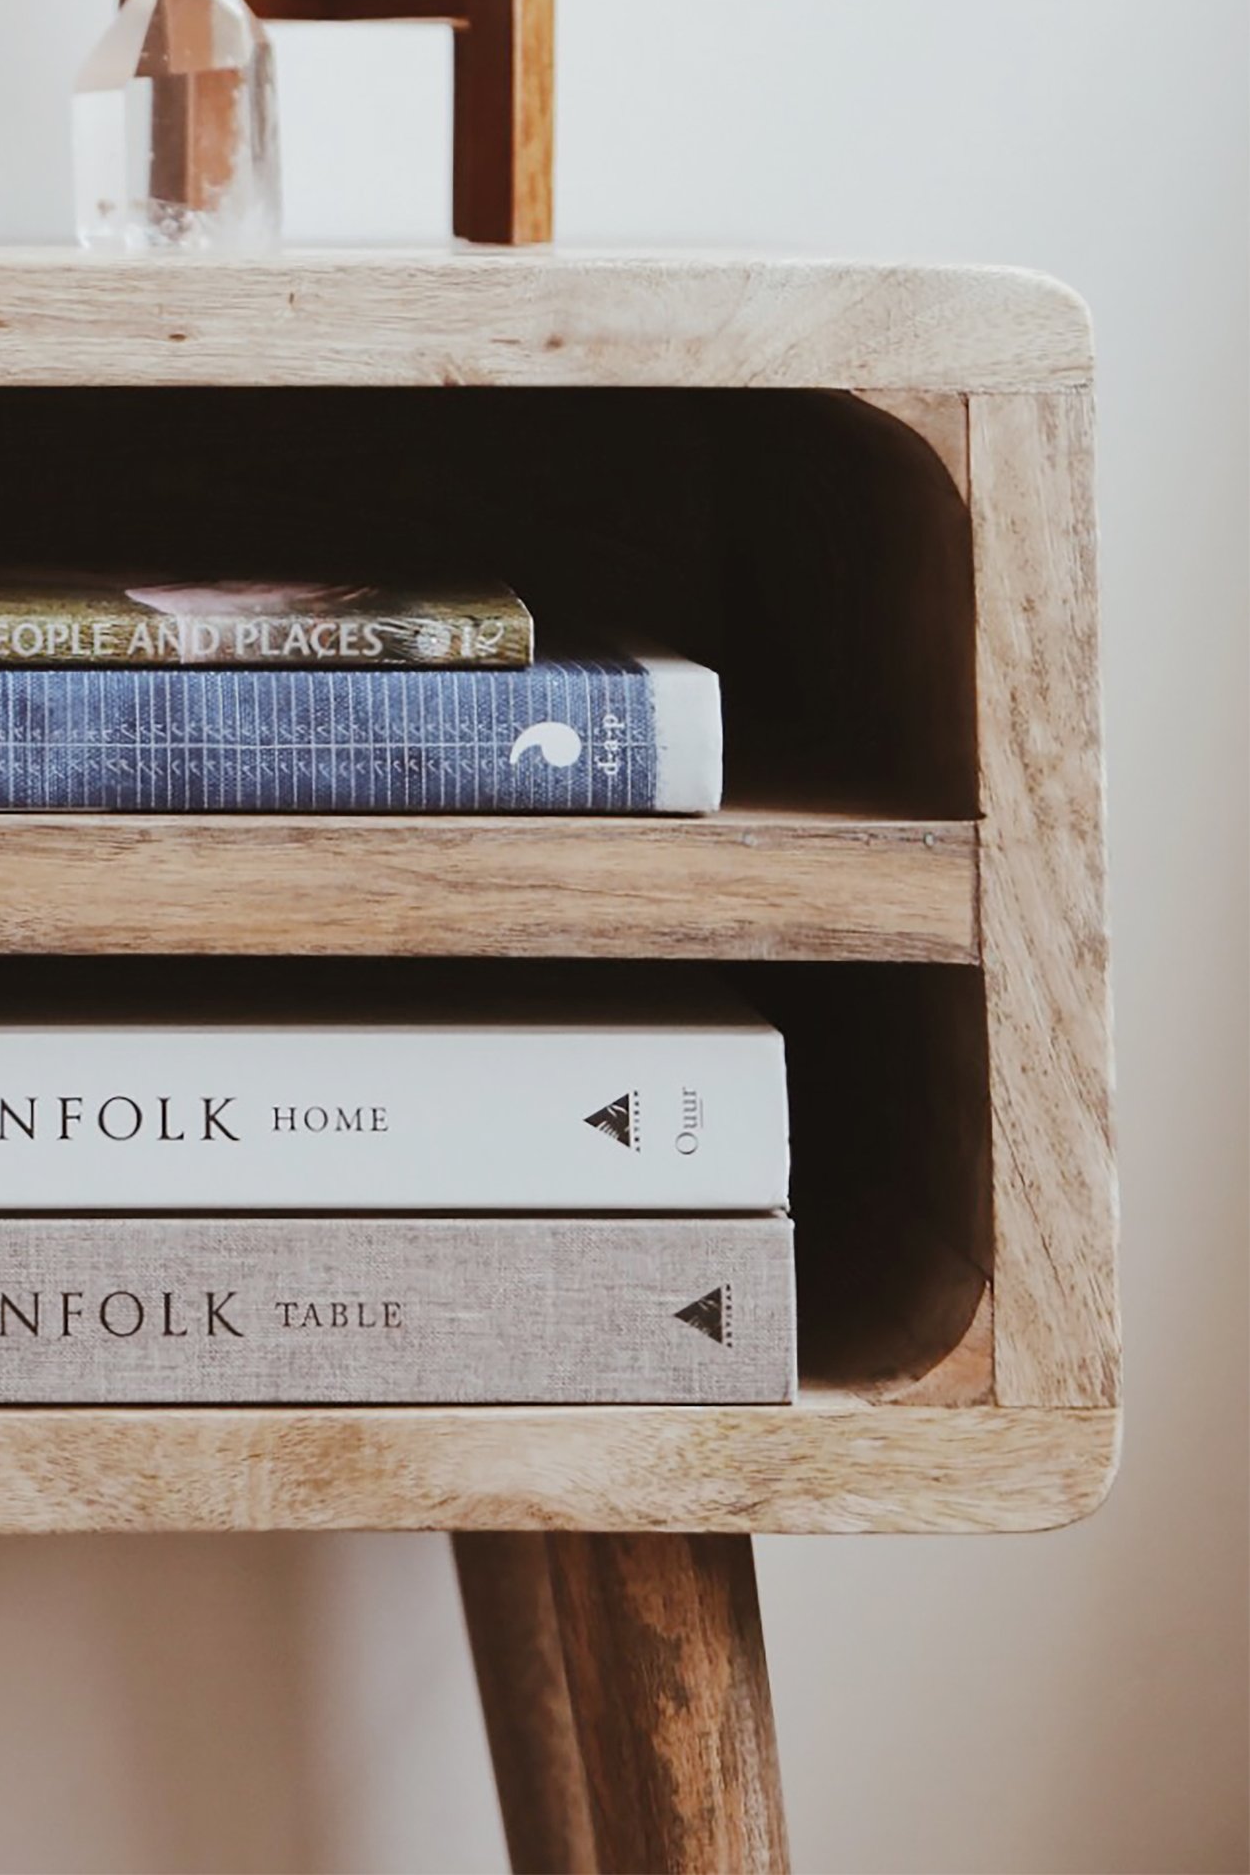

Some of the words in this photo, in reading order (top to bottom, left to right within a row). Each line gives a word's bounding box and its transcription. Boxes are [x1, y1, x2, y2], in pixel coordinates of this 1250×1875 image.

[130, 623, 221, 656] AND
[235, 622, 384, 658] PLACES
[272, 1106, 389, 1133] HOME
[675, 1086, 700, 1156] Ouur
[275, 1301, 403, 1329] TABLE
